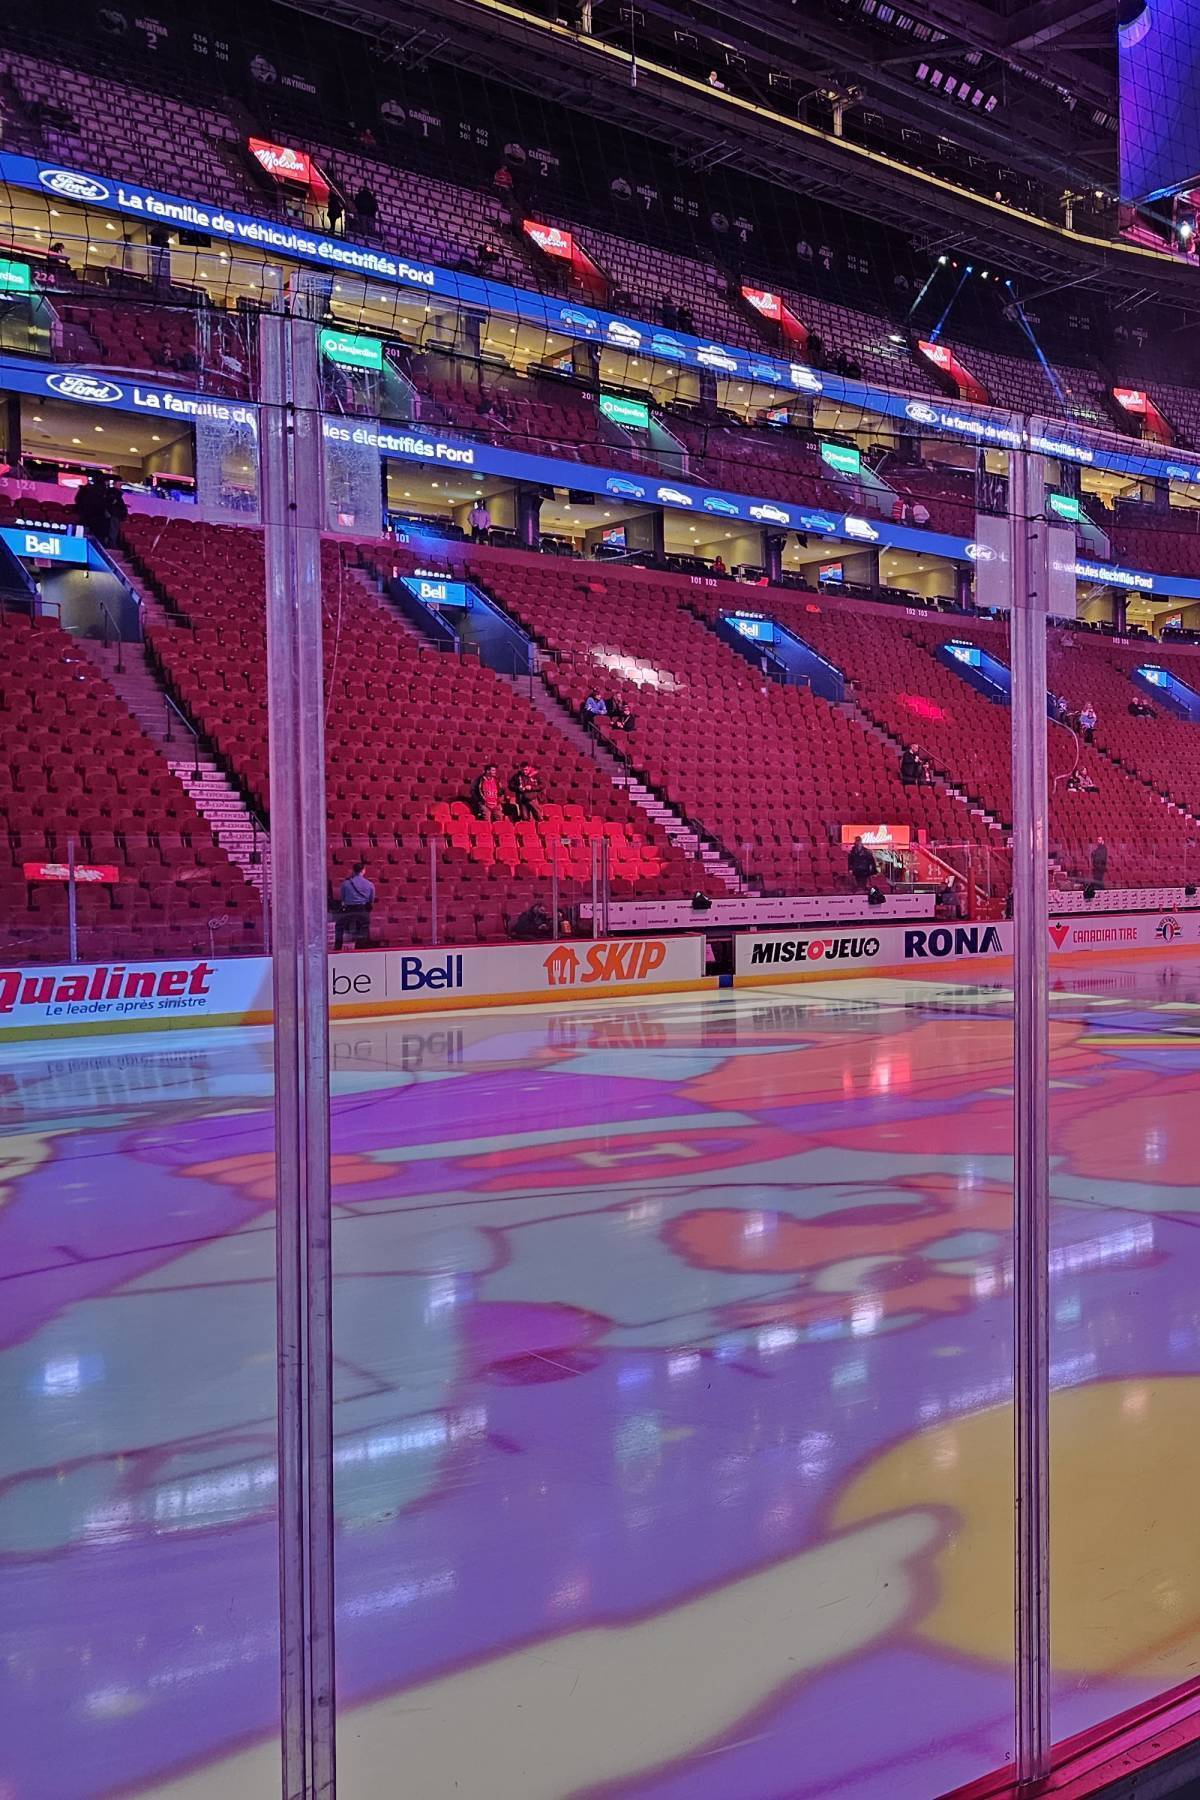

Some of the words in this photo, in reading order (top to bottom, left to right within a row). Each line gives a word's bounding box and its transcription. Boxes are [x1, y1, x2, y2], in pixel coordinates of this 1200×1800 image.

[147, 32, 159, 50] 2
[256, 147, 305, 174] Molson
[539, 161, 549, 177] 2
[50, 172, 98, 198] Ford
[118, 189, 142, 210] La
[145, 197, 209, 227] famille
[212, 214, 235, 233] de
[237, 222, 317, 254] véhicules
[317, 243, 396, 276] électrifiés
[398, 265, 434, 286] Ford
[33, 271, 55, 283] 224
[386, 347, 400, 357] 201
[59, 376, 110, 399] Ford
[134, 387, 159, 408] La
[162, 393, 230, 420] famille
[613, 404, 645, 418] Desjardins
[941, 414, 953, 425] La
[954, 419, 984, 434] famille
[353, 429, 434, 457] électrifiés
[436, 445, 473, 463] Ford
[16, 480, 36, 491] 124
[25, 535, 60, 555] Bell
[395, 532, 410, 543] 101
[690, 576, 702, 584] 101
[705, 578, 717, 586] 102
[1134, 576, 1152, 588] Ford
[420, 583, 446, 600] Bell
[906, 607, 916, 616] 102
[739, 622, 758, 637] Bell
[861, 831, 893, 843] Molson
[904, 926, 1003, 958] RONA
[1073, 929, 1116, 943] CANADIAN
[1119, 927, 1137, 940] TIRE
[581, 941, 666, 982] SKIP
[401, 955, 463, 991] Bell
[46, 1004, 62, 1016] Le
[66, 1001, 110, 1014] leader
[118, 999, 153, 1013] après
[157, 997, 207, 1009] sinistre
